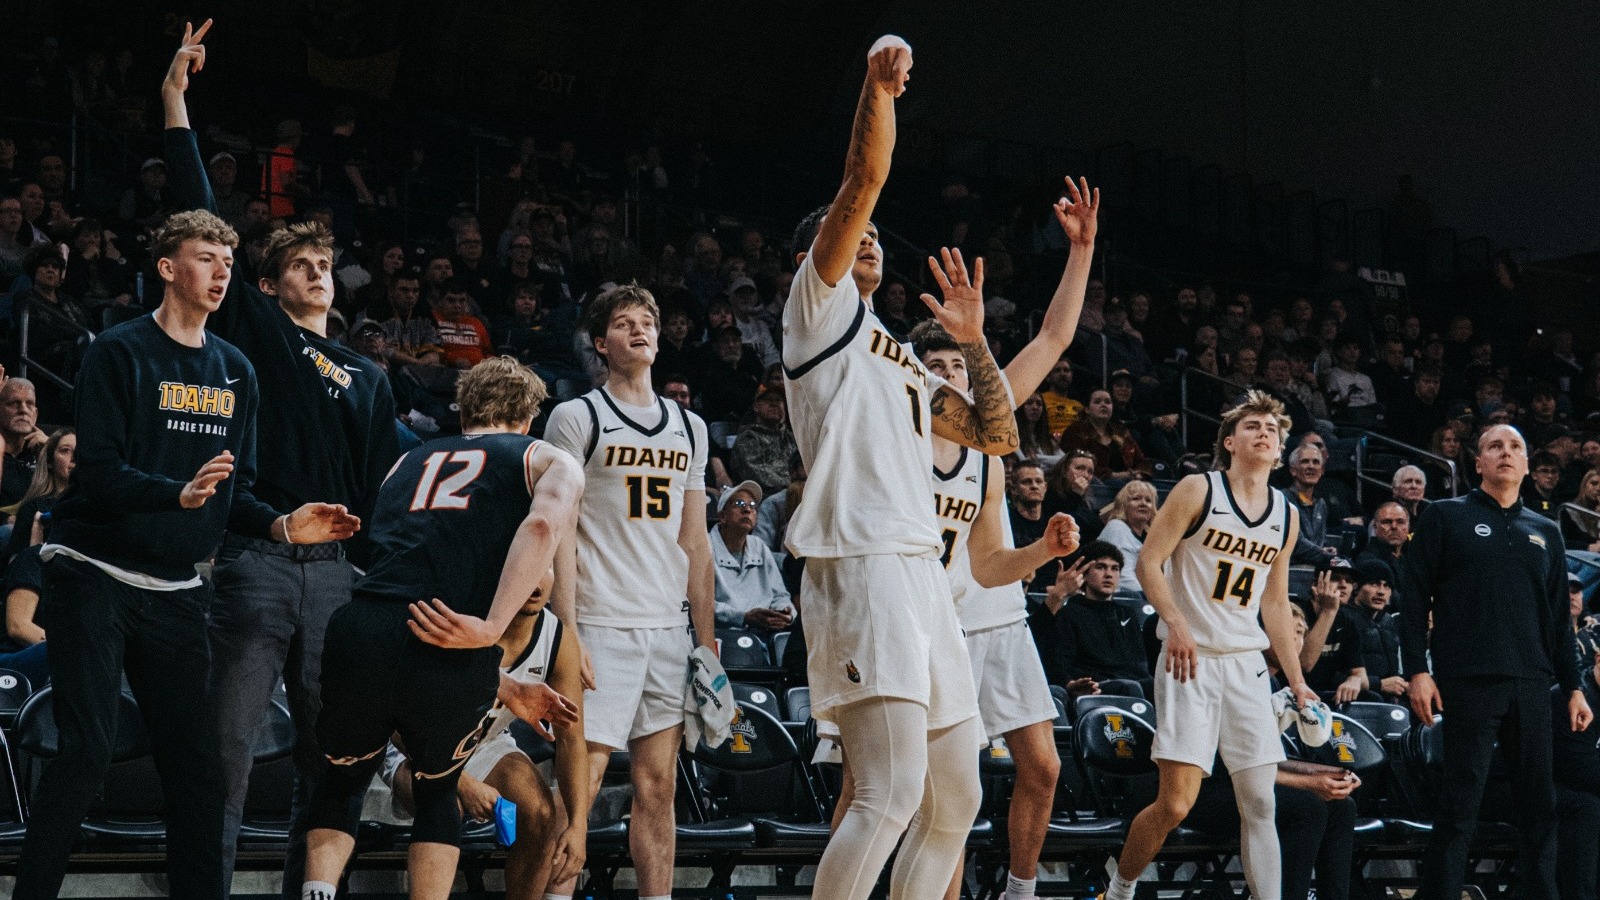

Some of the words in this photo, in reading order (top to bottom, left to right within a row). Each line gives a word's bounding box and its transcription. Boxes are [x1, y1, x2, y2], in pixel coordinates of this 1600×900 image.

[159, 381, 236, 418] IDAHO
[905, 383, 923, 438] 1
[166, 419, 227, 437] BASKETBALL
[605, 445, 689, 472] IDAHO
[408, 447, 488, 513] 12
[626, 475, 672, 519] 15
[1202, 528, 1278, 565] IDAHO
[1212, 559, 1256, 607] 14
